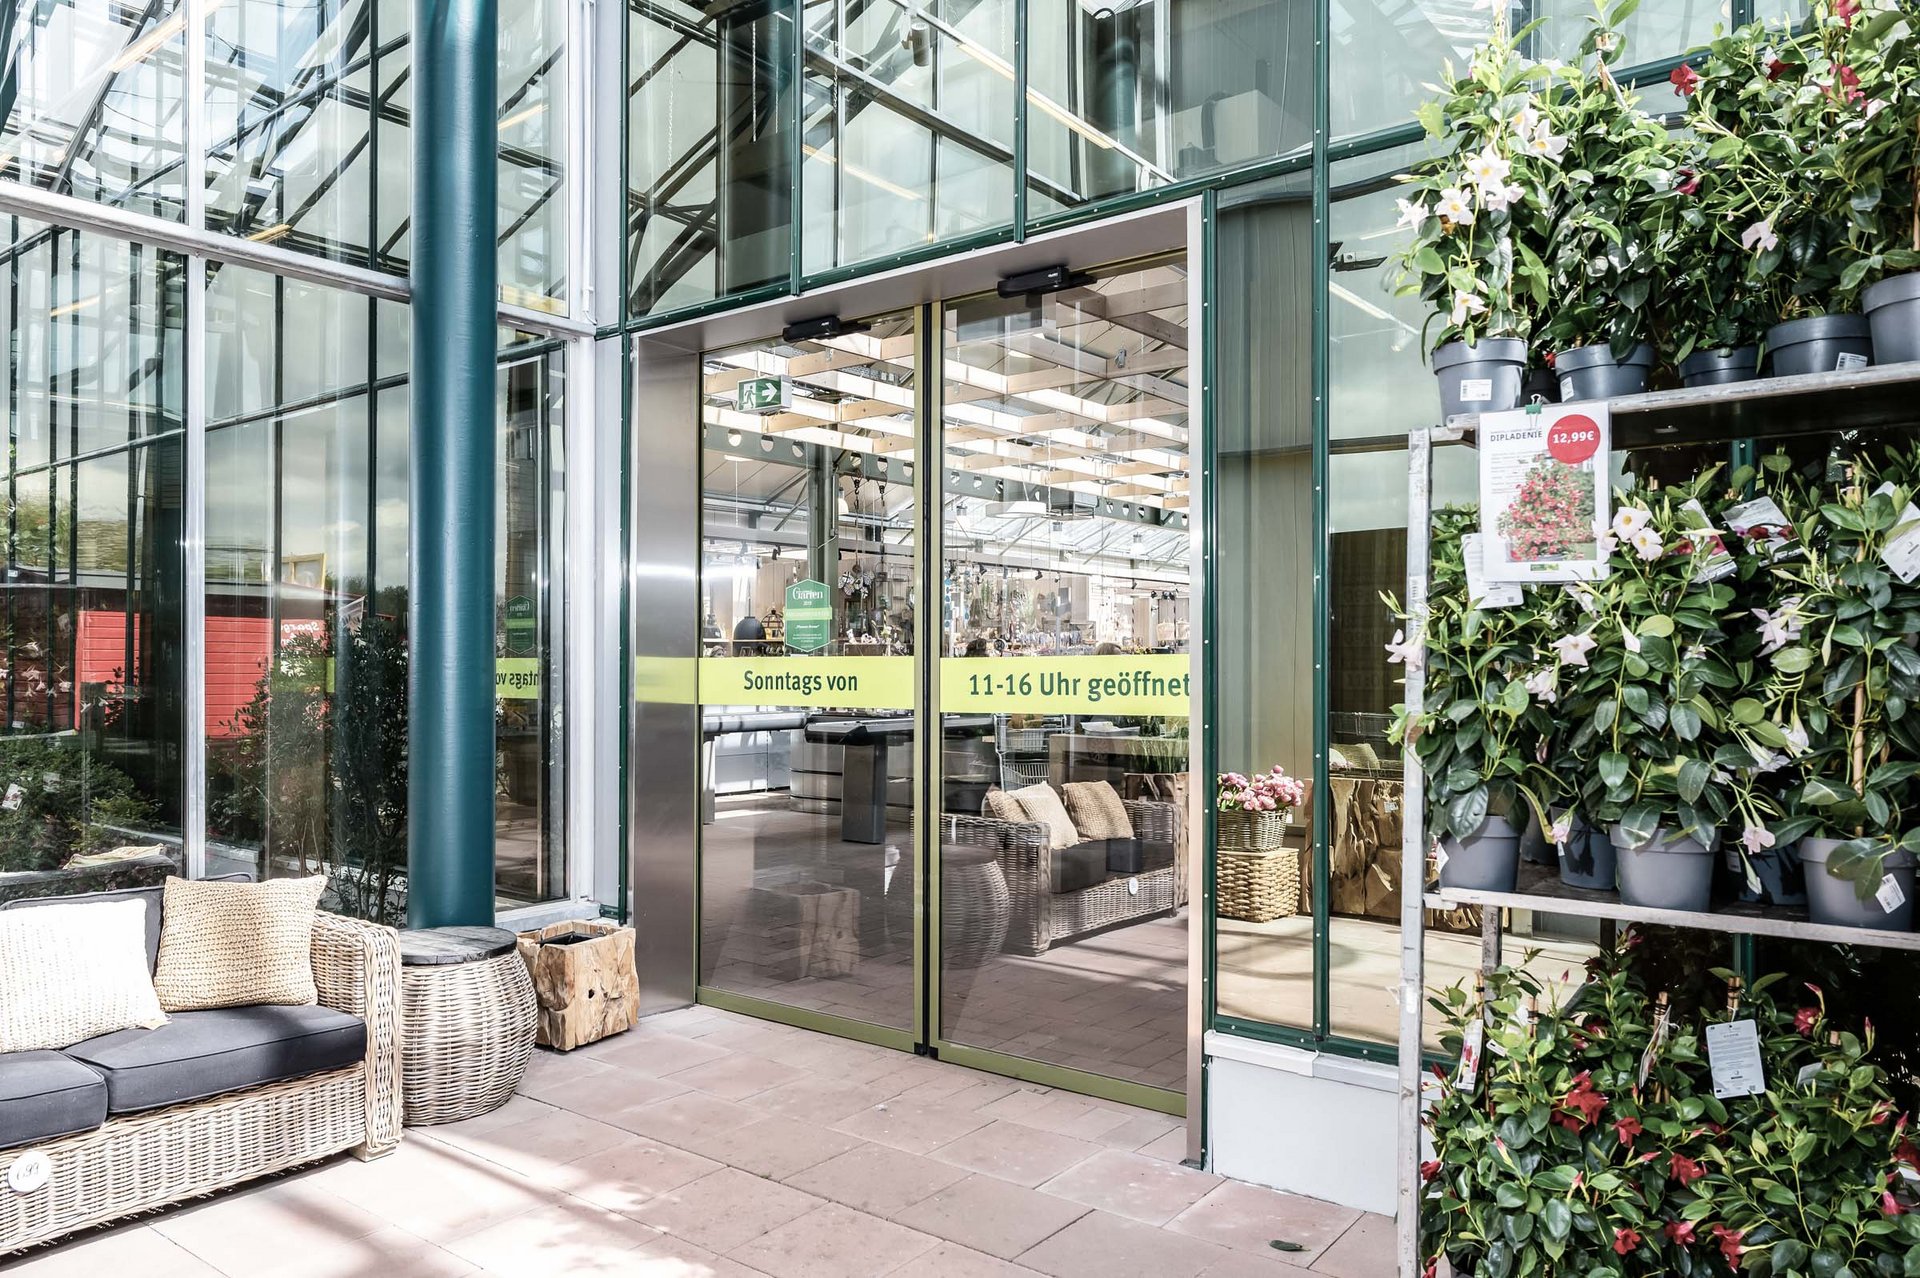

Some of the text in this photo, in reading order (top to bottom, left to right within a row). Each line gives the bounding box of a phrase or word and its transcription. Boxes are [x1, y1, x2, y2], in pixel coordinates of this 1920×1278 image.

[1490, 430, 1543, 442] DIPLADENIE
[1552, 430, 1595, 445] 12,99€
[743, 669, 858, 696] Sonntags von
[969, 670, 1190, 702] 11-16 Uhr geöffnet
